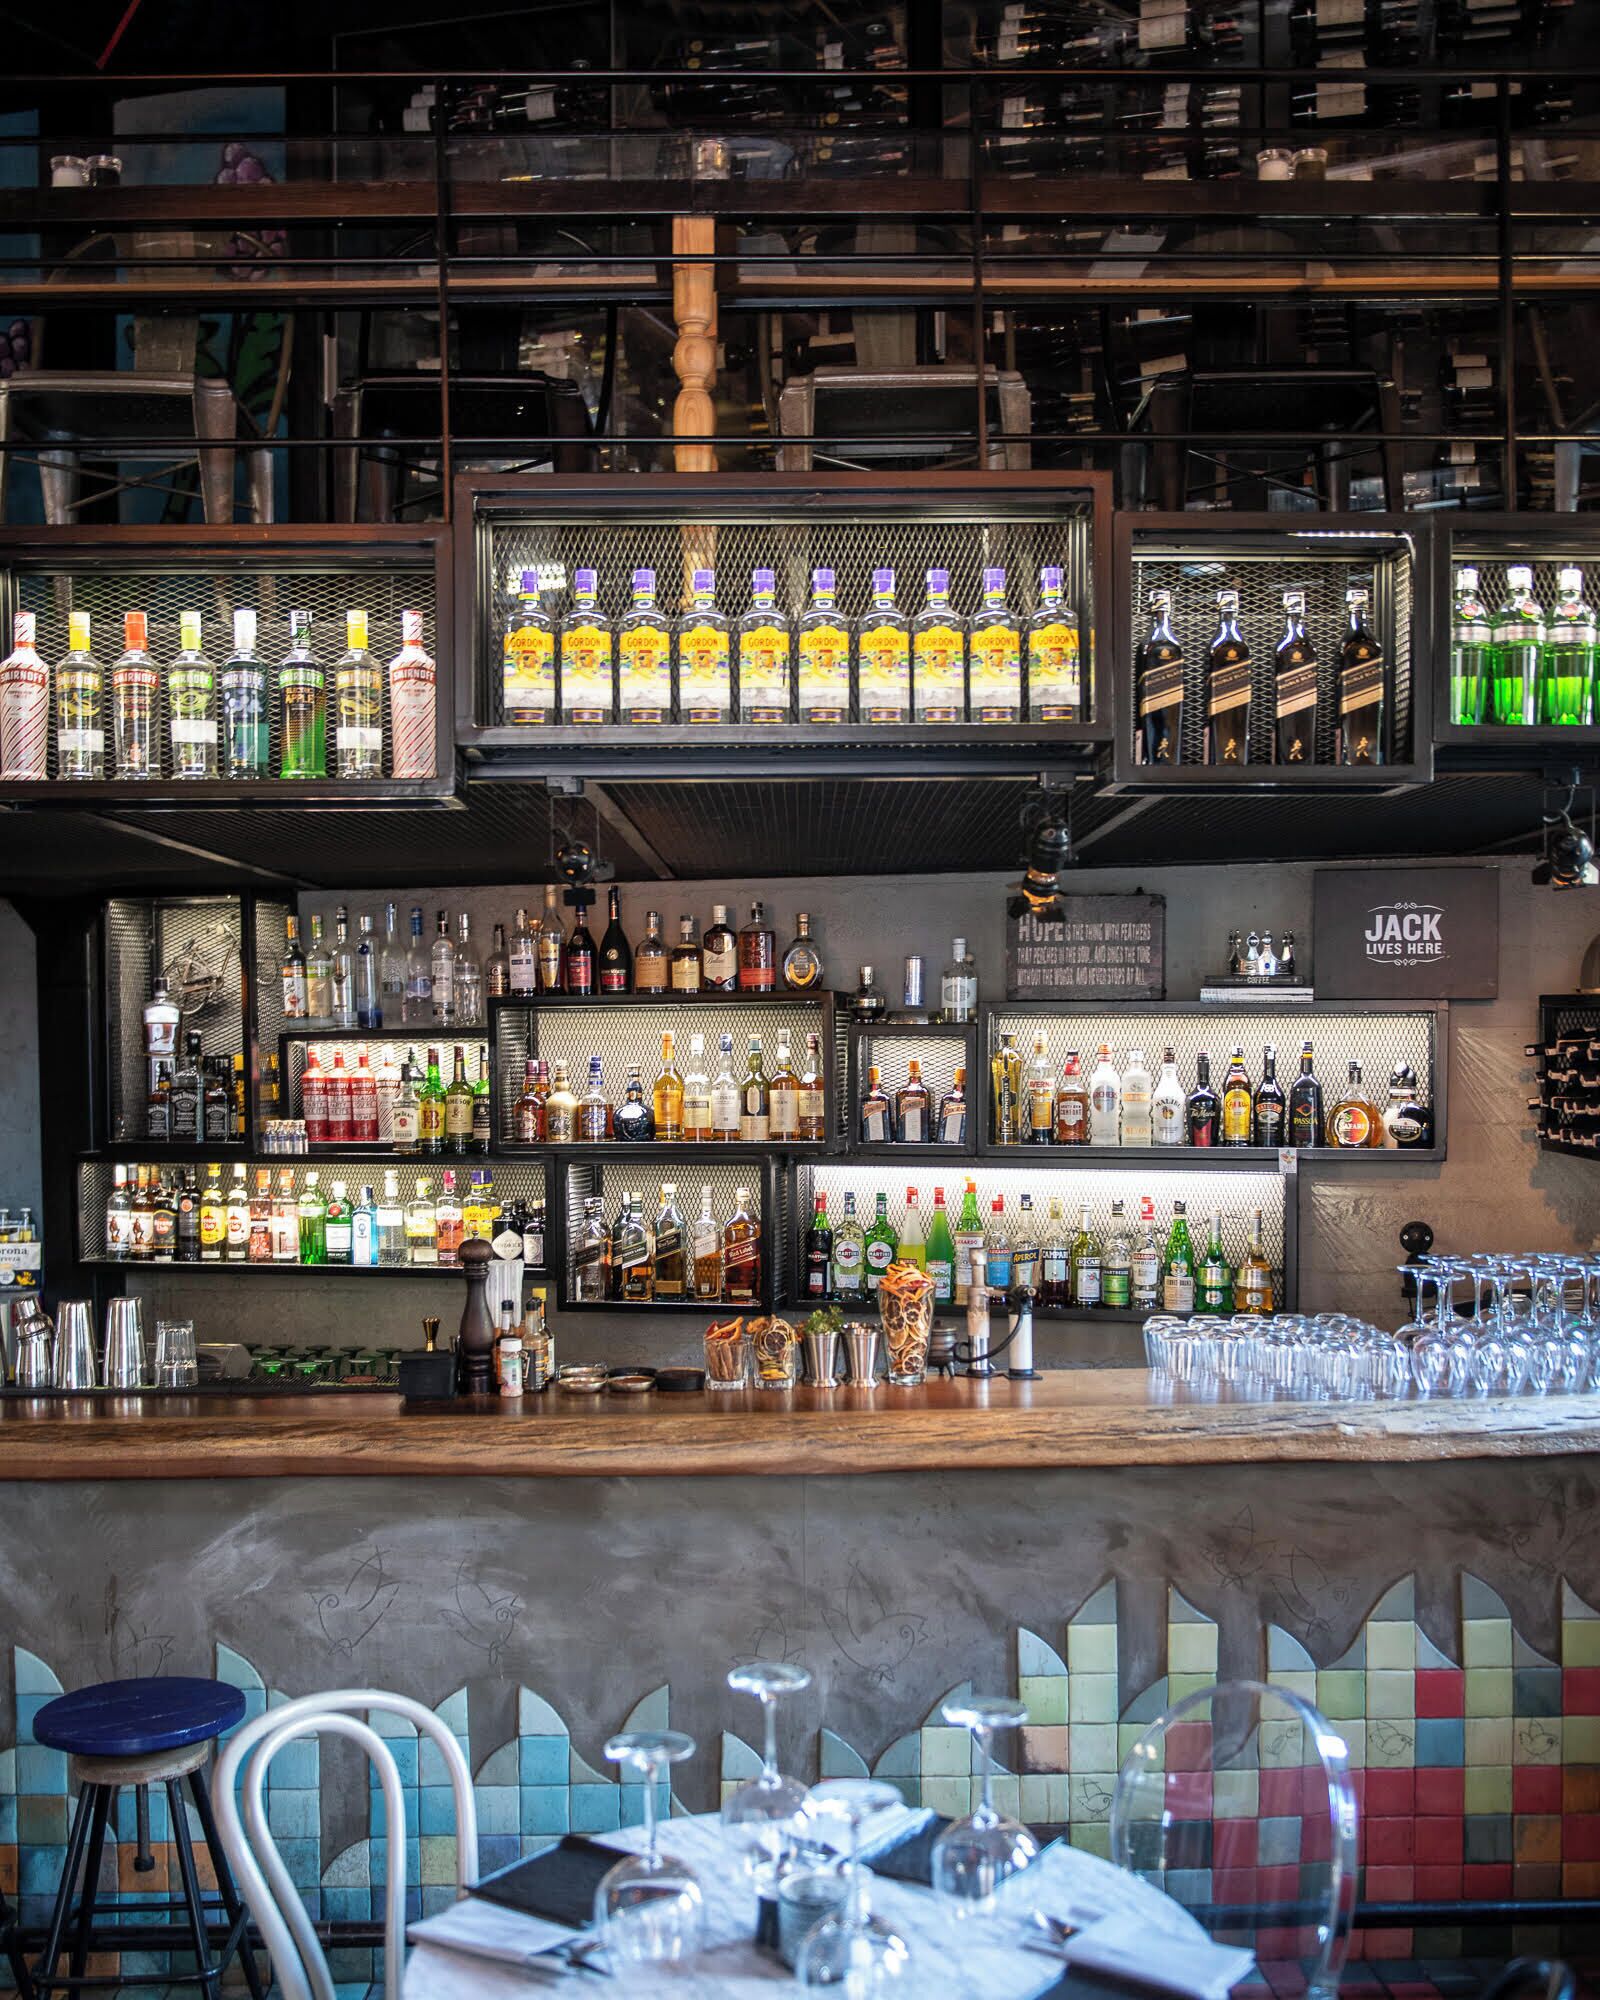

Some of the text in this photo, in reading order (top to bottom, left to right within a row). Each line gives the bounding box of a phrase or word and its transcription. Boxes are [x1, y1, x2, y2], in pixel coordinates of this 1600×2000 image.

[1, 670, 44, 684] SMIRNOFF
[114, 671, 157, 687] SMIRNOFF
[393, 668, 435, 684] SMIRNOFF
[1365, 913, 1442, 942] JACK
[1366, 943, 1443, 955] LIVES HERE
[1246, 976, 1270, 984] COFFEE
[447, 1098, 471, 1106] AMESON
[1156, 1098, 1181, 1107] MALIBU
[1200, 1109, 1216, 1118] Maria
[1339, 1122, 1365, 1131] SAFARI
[729, 1245, 754, 1257] Red Label
[1042, 1250, 1069, 1259] CAMPARI
[1013, 1252, 1037, 1263] APEROL
